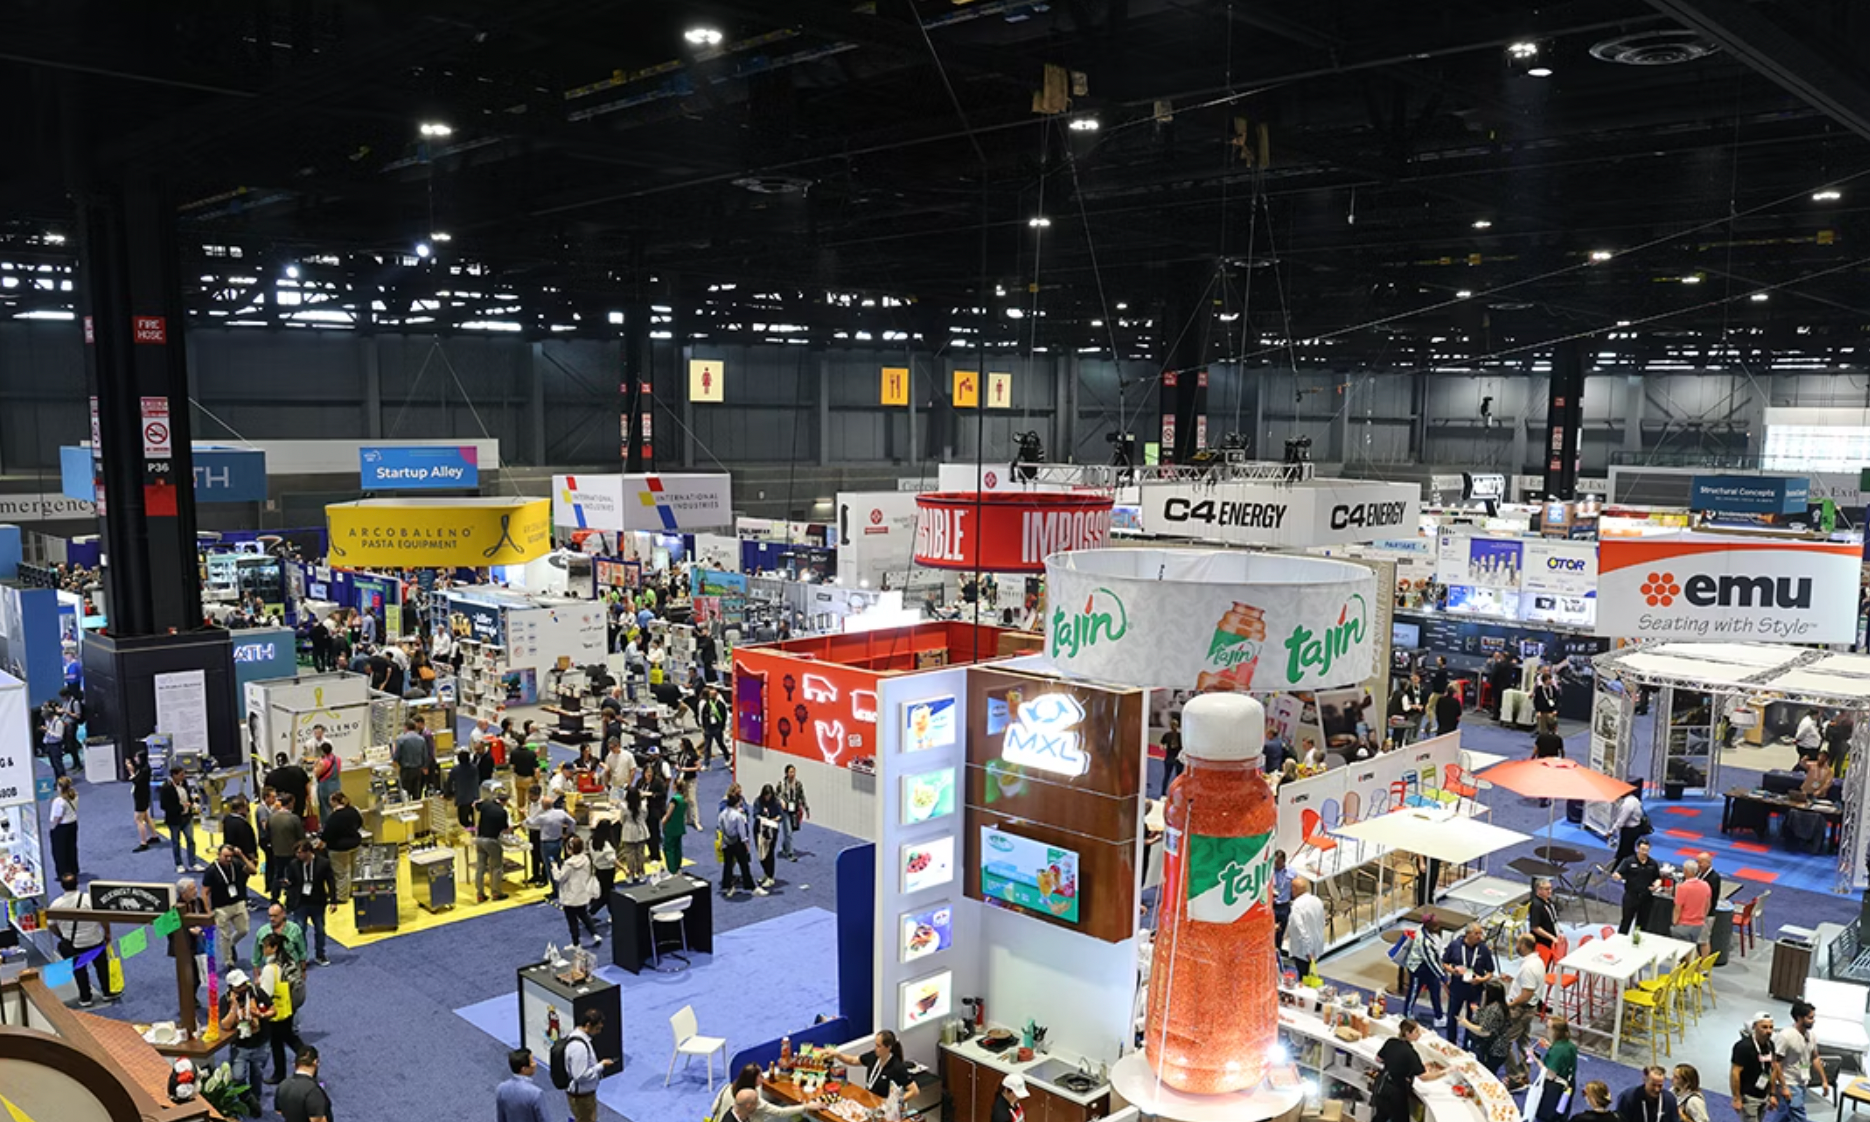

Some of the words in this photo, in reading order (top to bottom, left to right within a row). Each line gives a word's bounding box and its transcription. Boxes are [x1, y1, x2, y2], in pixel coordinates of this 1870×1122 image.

[138, 319, 160, 330] FIRE
[137, 330, 163, 340] HOSE
[147, 463, 170, 473] P36
[376, 466, 428, 480] Startup
[431, 465, 464, 480] Alley
[655, 493, 719, 502] INTERNATIONAL
[1700, 485, 1737, 496] Structural
[1739, 487, 1776, 498] Concepts
[0, 500, 97, 516] mergency
[673, 501, 719, 510] INDUSTRIES
[1164, 497, 1217, 524] C4
[1218, 501, 1288, 529] ENERGY
[1330, 504, 1367, 531] C4
[1367, 501, 1407, 528] ENERGY
[349, 526, 472, 538] ARCOBALENO
[361, 539, 394, 549] PASTA
[397, 539, 458, 550] EQUIPMENT
[1684, 573, 1813, 609] emu
[1638, 613, 1709, 635] Seating
[1714, 616, 1754, 633] with
[1008, 728, 1078, 762] MXL
